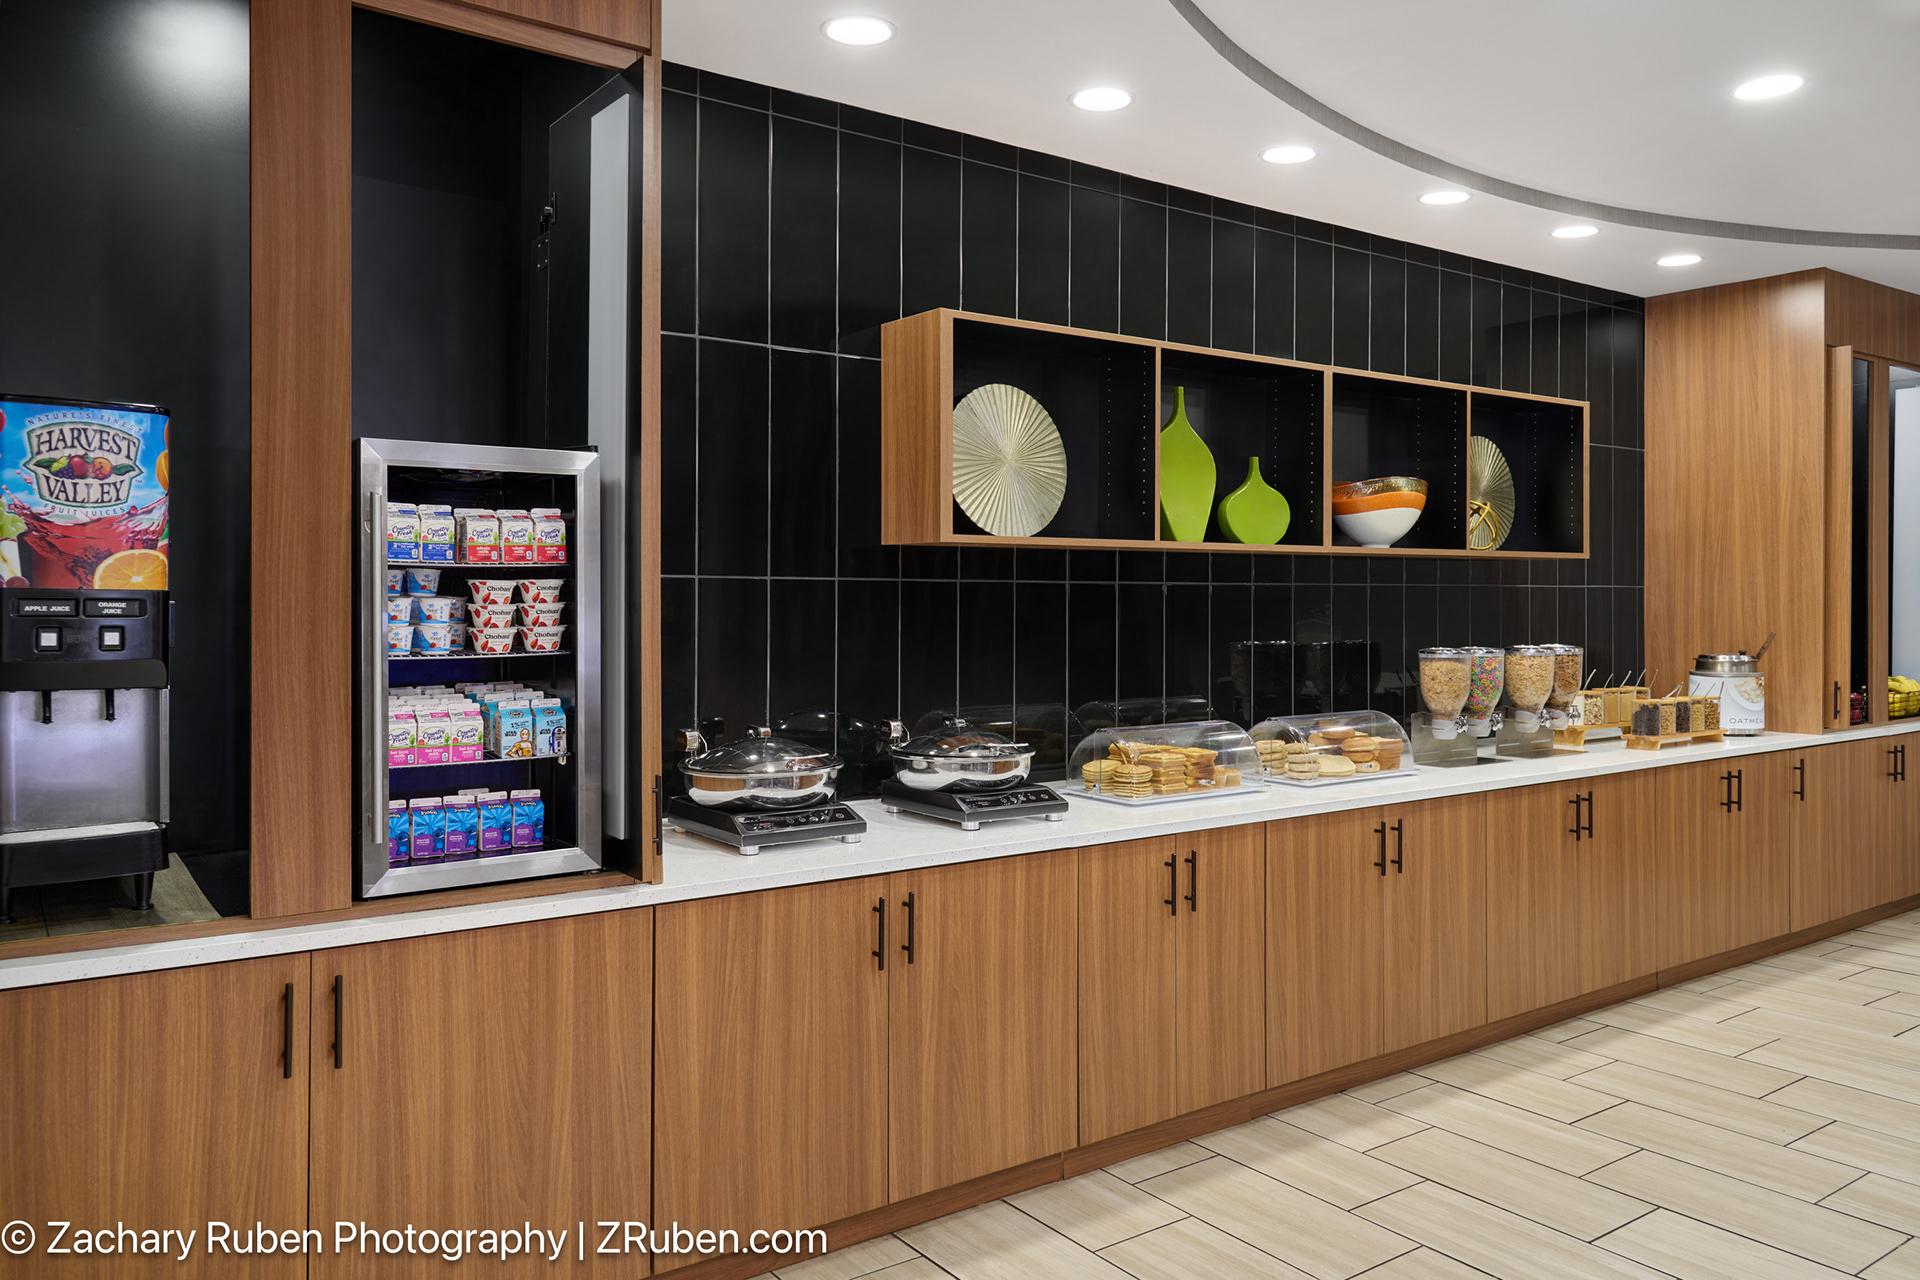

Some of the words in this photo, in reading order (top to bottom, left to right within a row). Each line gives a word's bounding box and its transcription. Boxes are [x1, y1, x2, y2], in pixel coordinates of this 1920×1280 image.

[28, 412, 91, 425] NATURE'S
[100, 415, 142, 434] FINEST
[35, 427, 136, 460] HARVEST
[42, 474, 126, 504] VALLEY
[44, 504, 77, 515] FRUIT
[86, 507, 126, 516] JUICES
